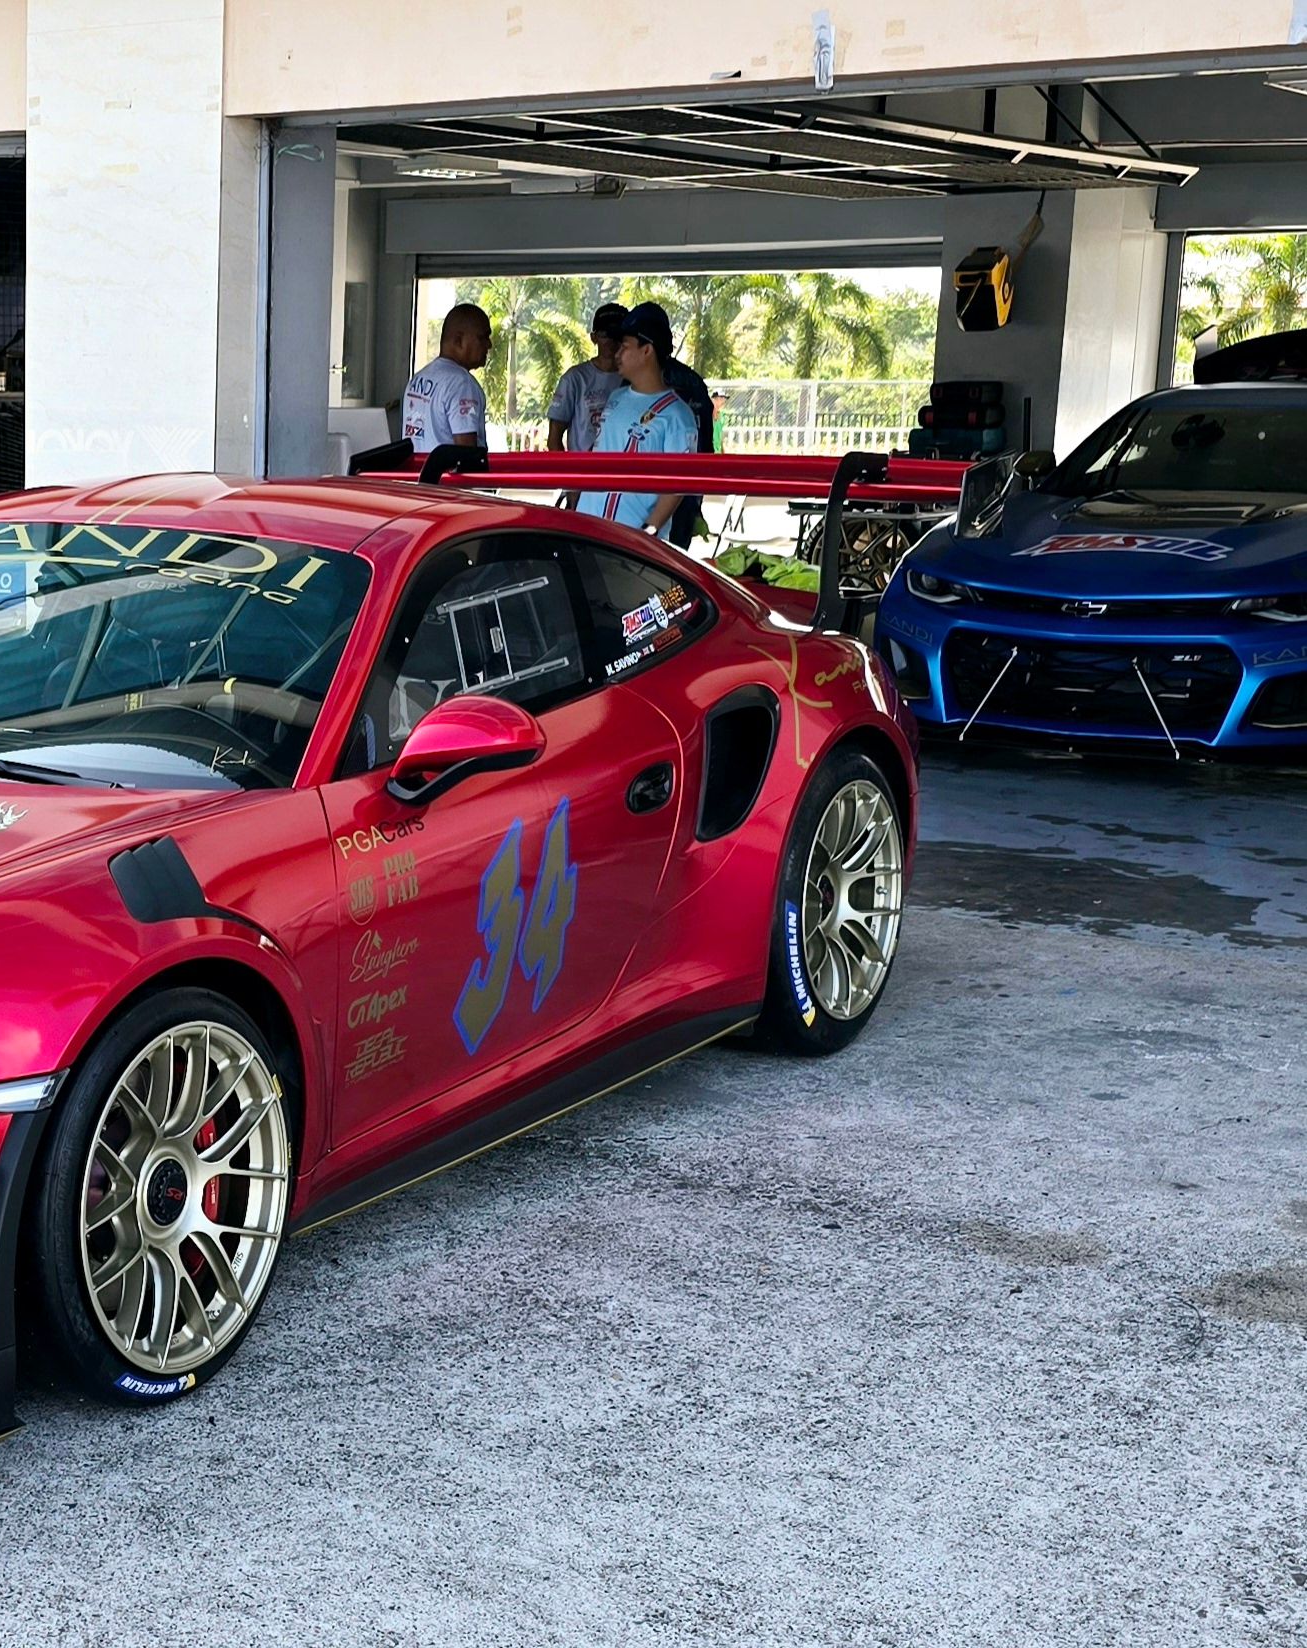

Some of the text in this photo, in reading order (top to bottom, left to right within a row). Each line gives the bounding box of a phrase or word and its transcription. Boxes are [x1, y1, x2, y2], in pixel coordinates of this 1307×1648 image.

[1018, 534, 1234, 561] AMSOIL
[124, 562, 298, 605] racing
[622, 603, 655, 638] AMSOIL
[452, 795, 579, 1057] 34
[787, 910, 809, 1001] MICHELIN
[120, 1375, 178, 1396] MICHELIN
